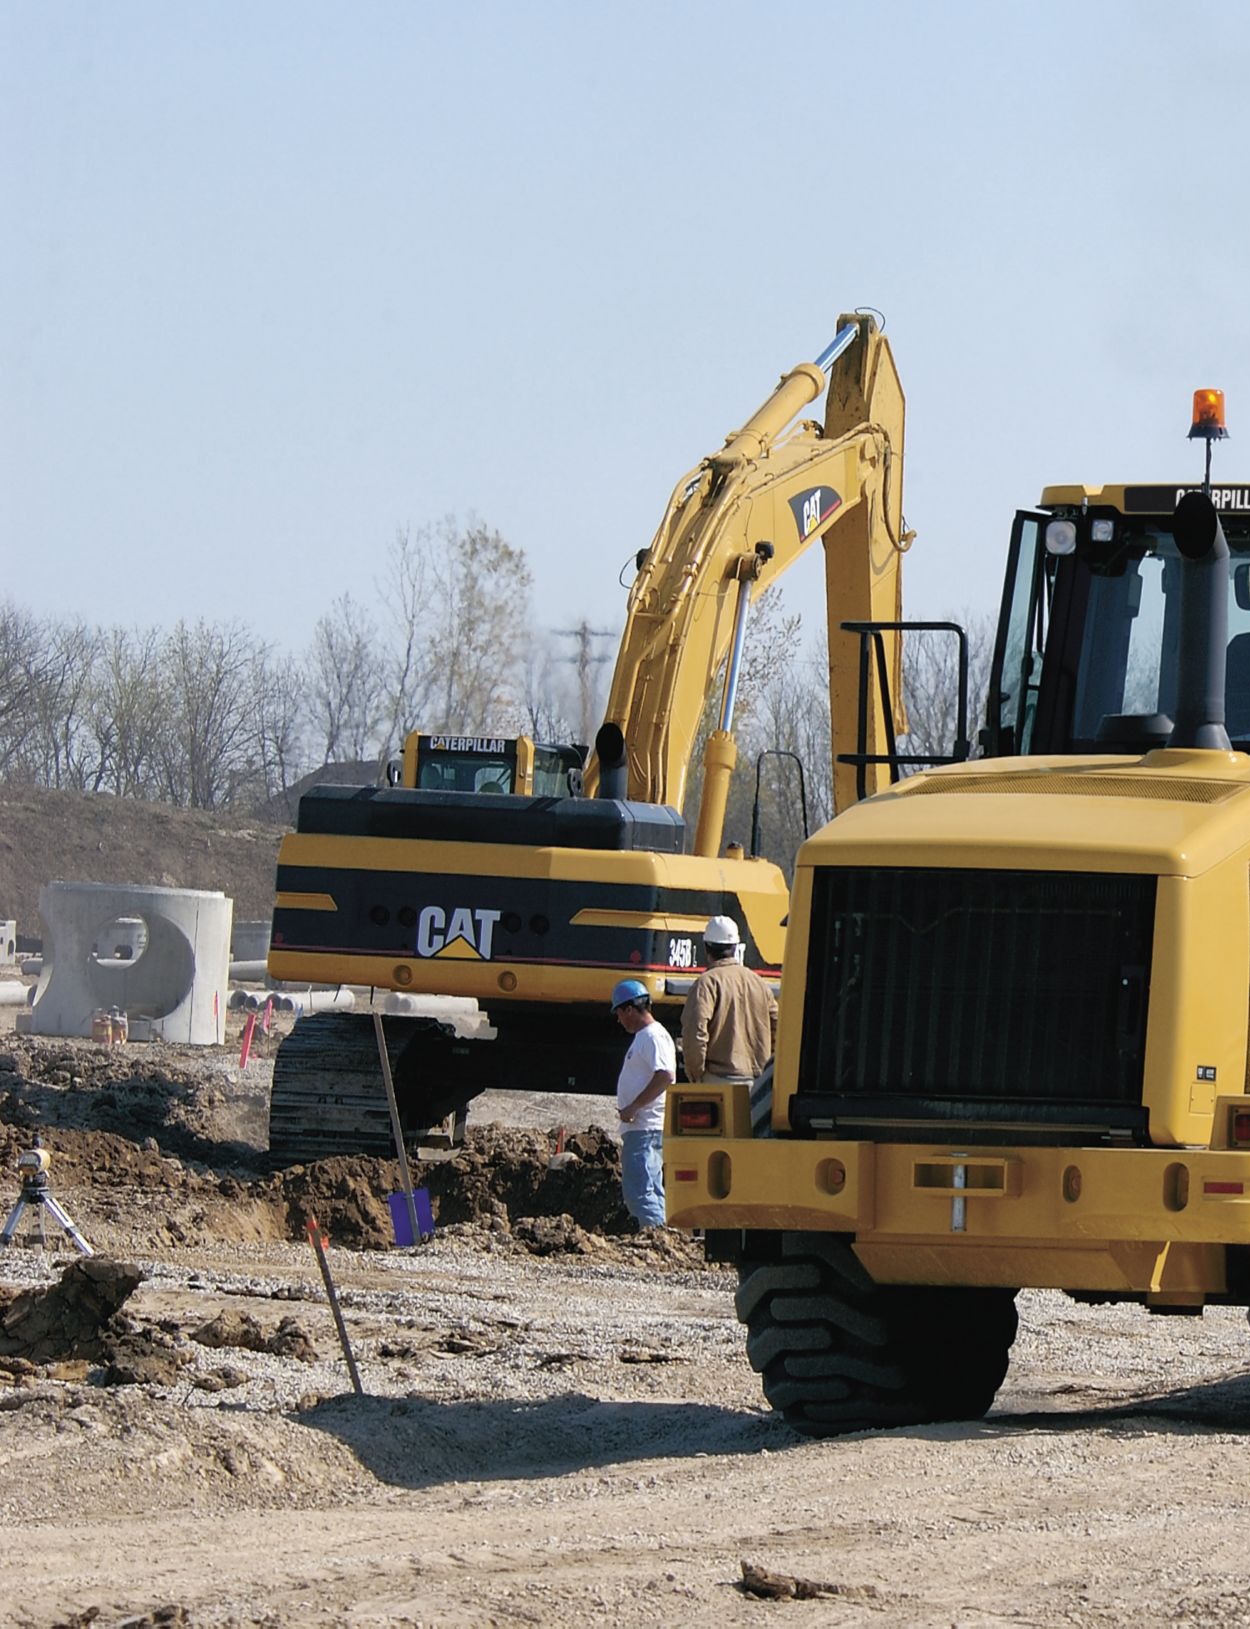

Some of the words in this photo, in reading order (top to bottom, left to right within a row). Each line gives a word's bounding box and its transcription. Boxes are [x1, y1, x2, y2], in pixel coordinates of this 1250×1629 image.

[803, 488, 821, 537] CAT
[429, 736, 506, 754] CATERPILLAR
[416, 905, 501, 960] CAT
[669, 938, 692, 967] 345B
